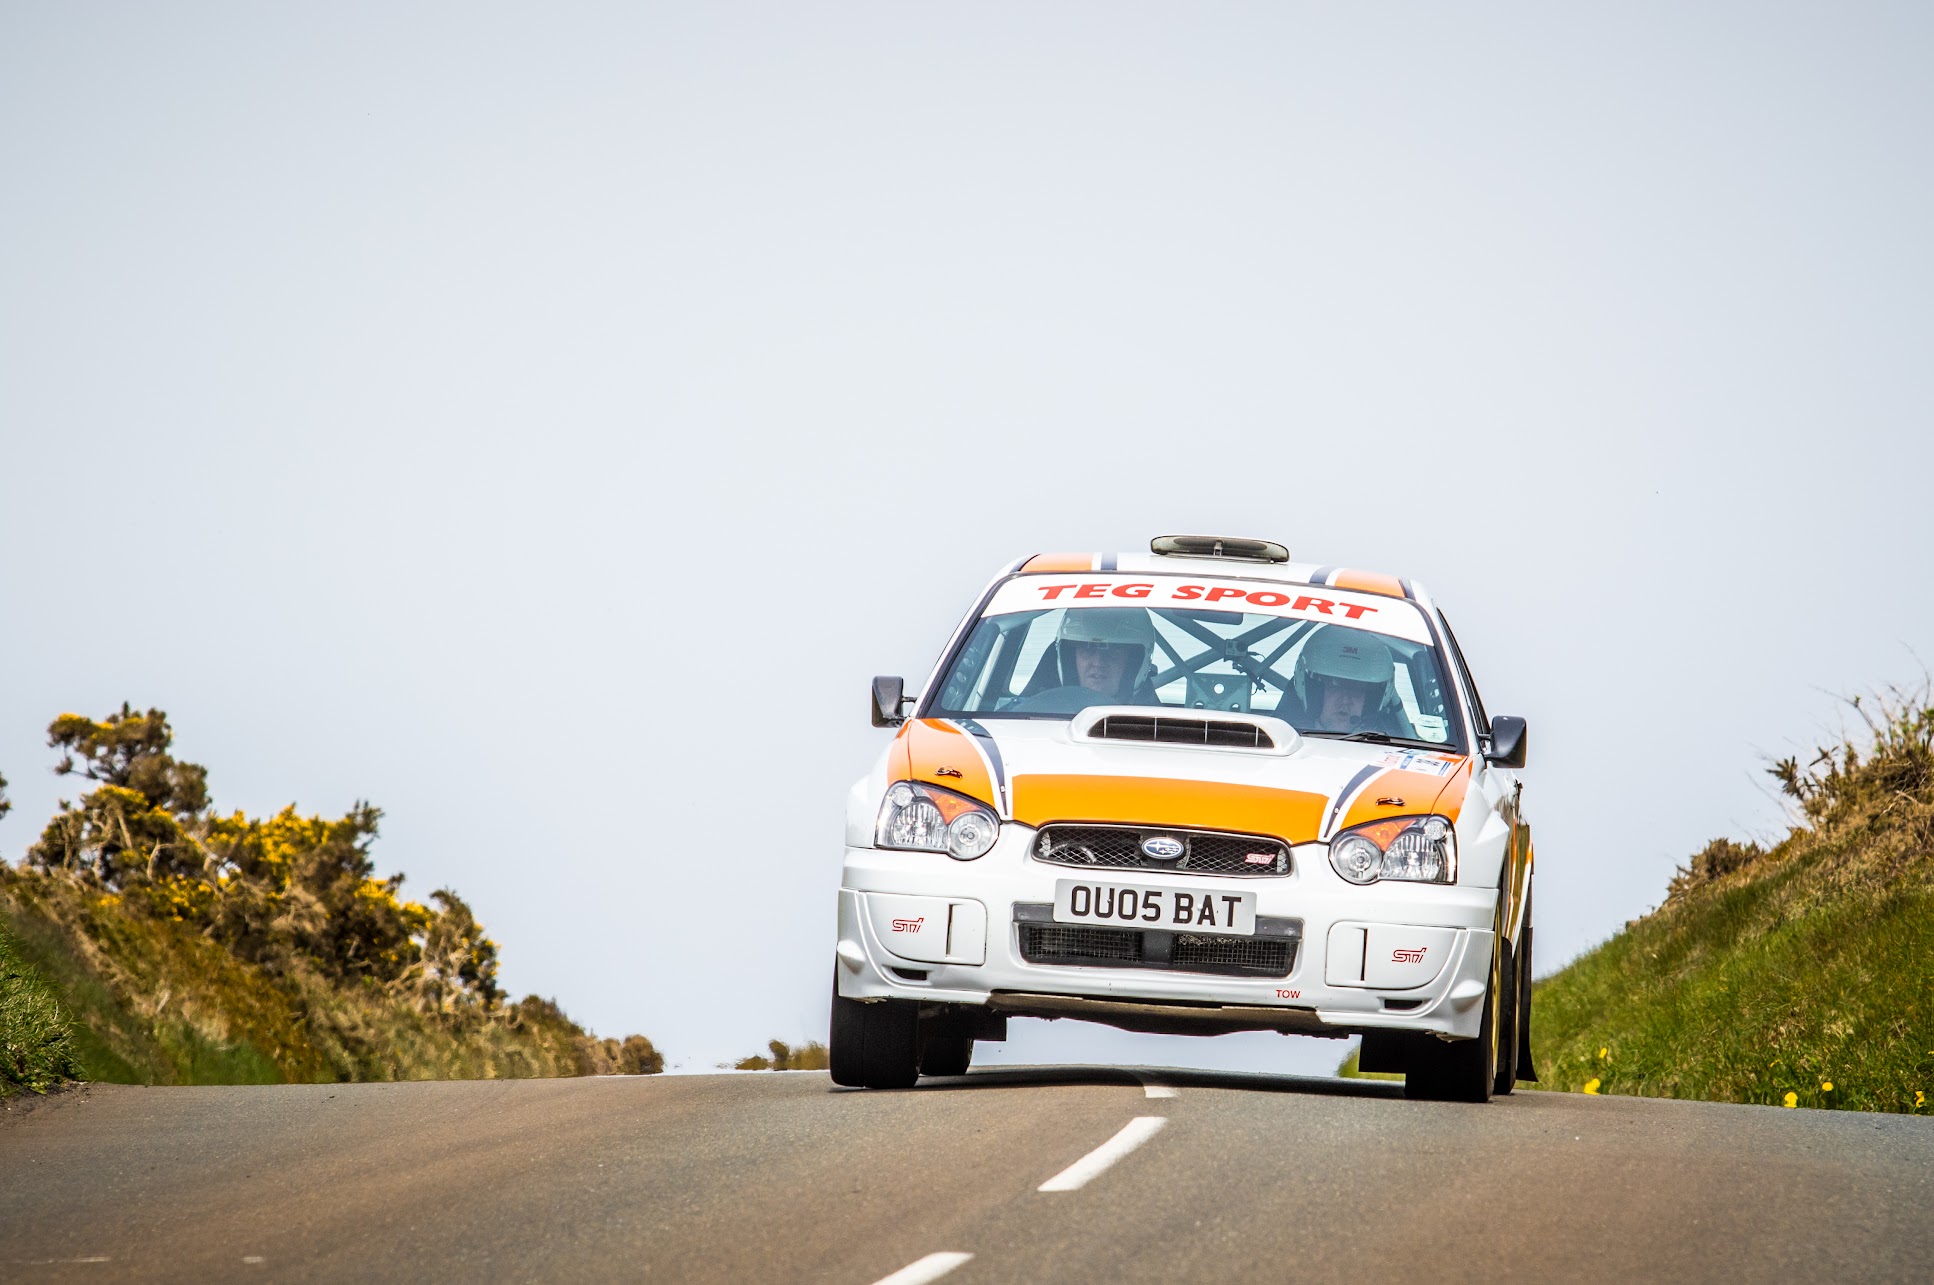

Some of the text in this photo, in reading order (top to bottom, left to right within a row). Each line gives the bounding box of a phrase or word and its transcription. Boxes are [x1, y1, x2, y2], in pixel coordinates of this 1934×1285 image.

[1037, 583, 1379, 620] TEG SPORT
[1343, 646, 1358, 655] 3M
[1070, 885, 1242, 928] OU05 BAT
[1275, 989, 1301, 999] TOW
